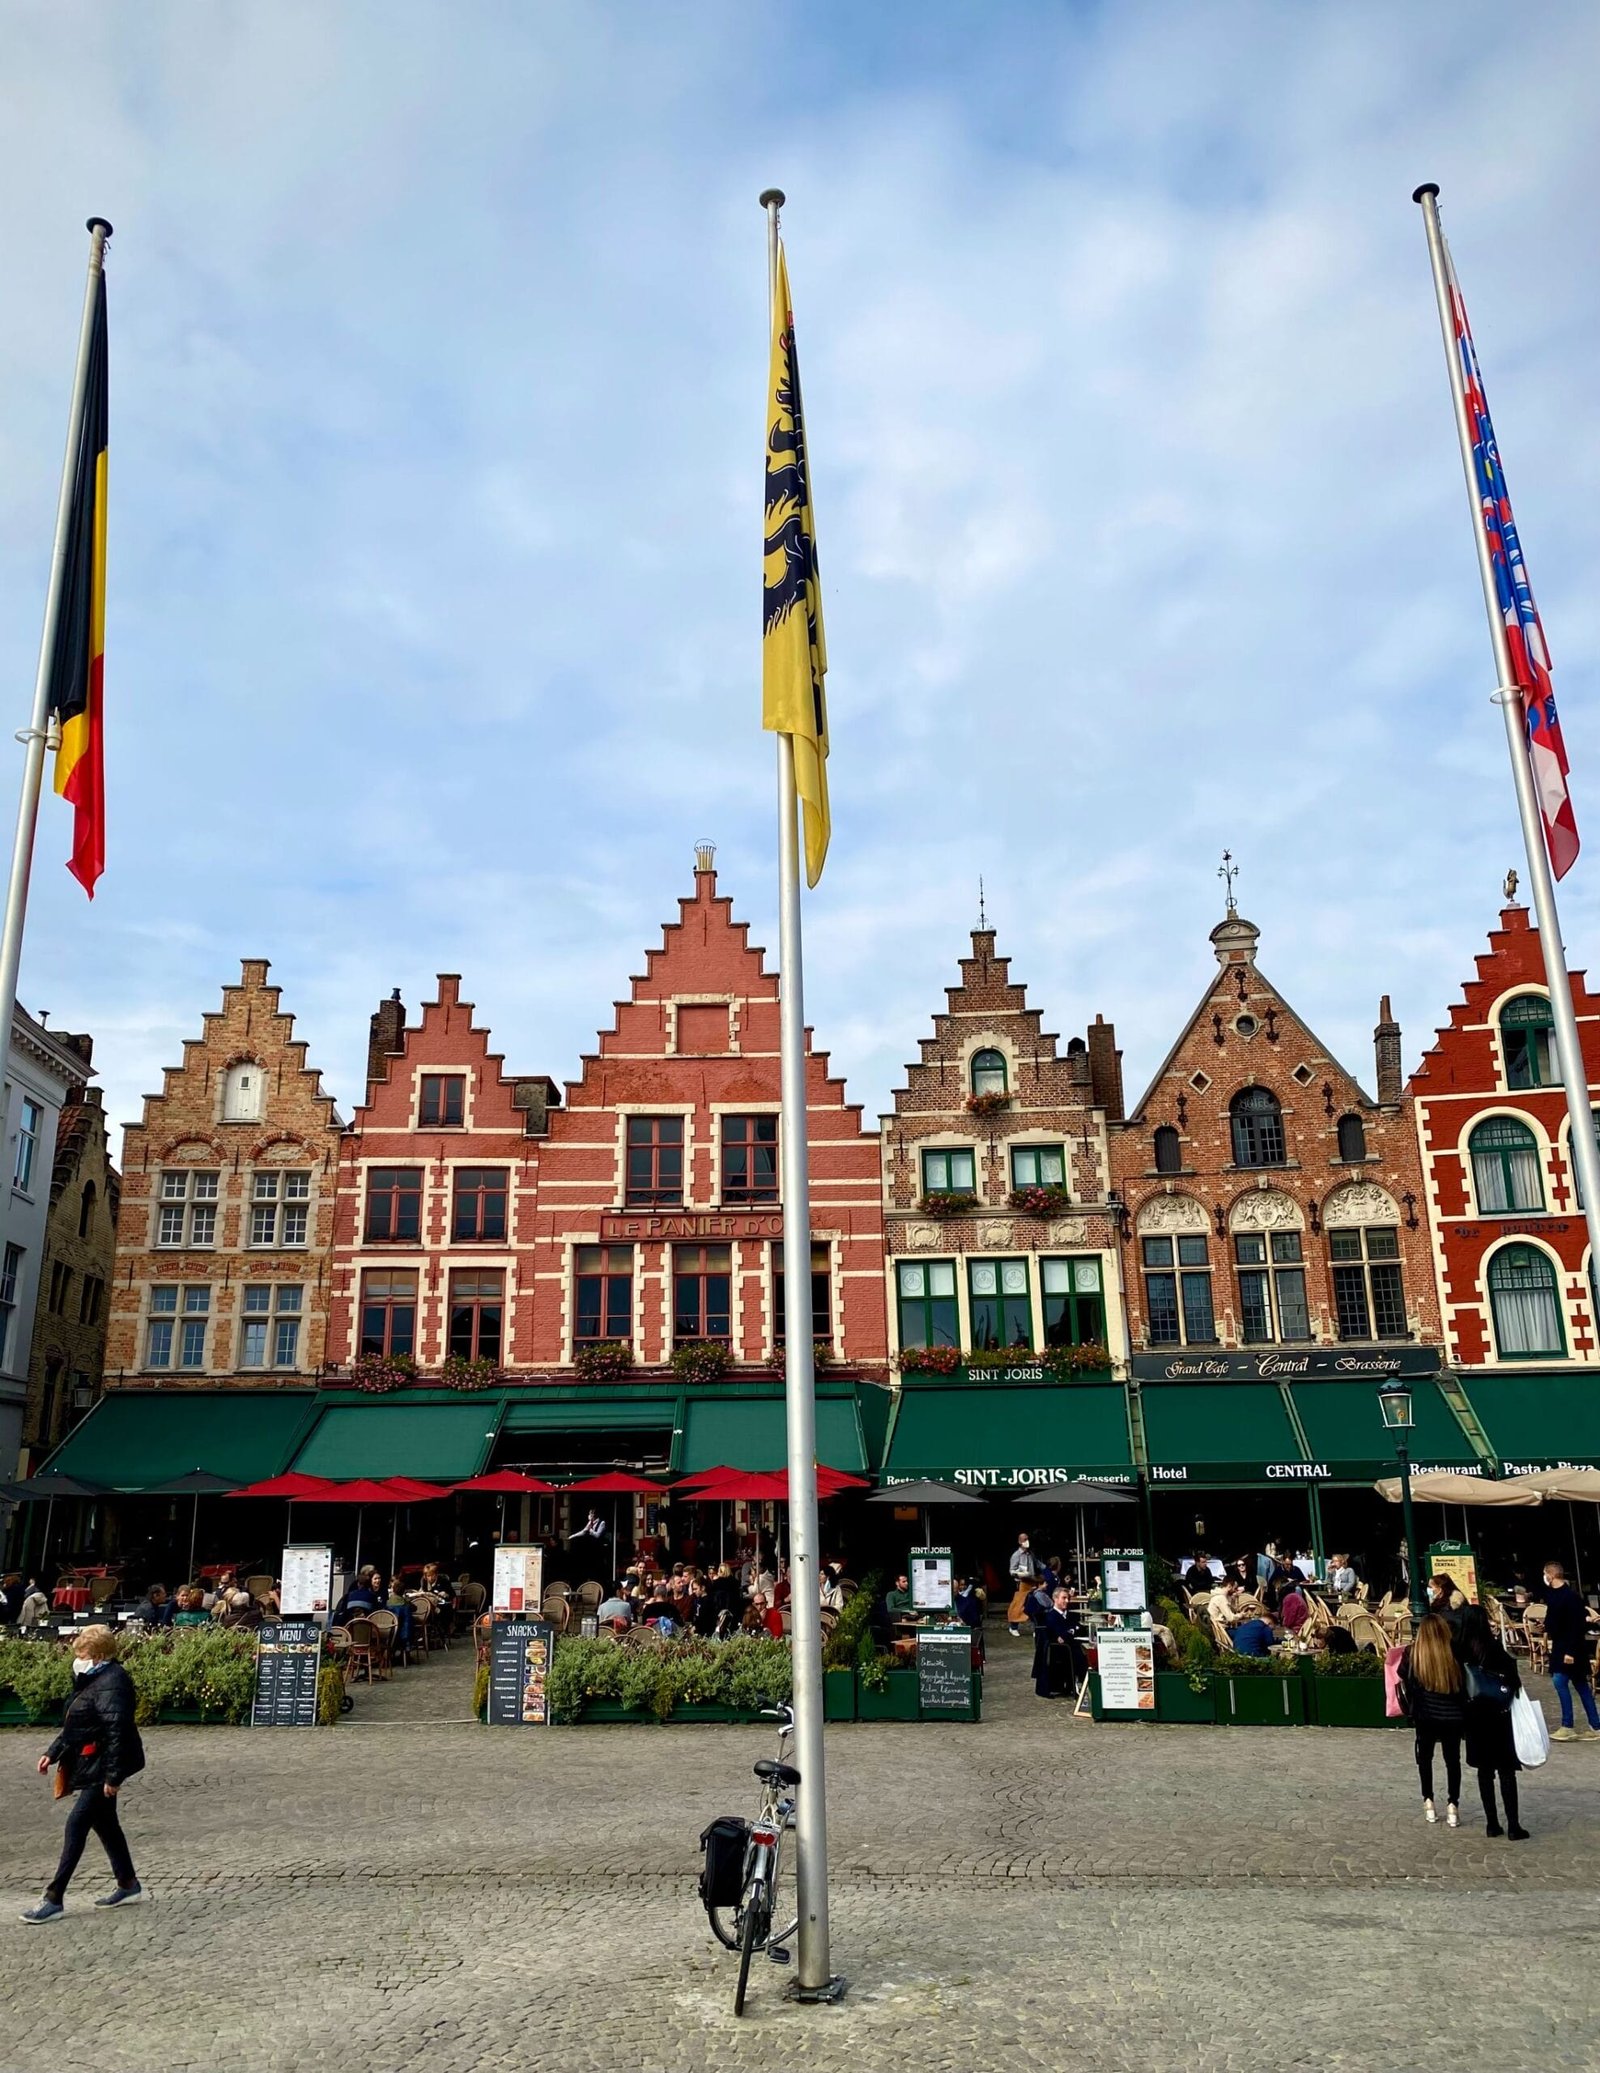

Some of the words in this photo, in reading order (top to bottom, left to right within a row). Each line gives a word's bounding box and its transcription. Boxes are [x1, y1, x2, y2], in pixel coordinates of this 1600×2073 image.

[608, 1222, 640, 1238] LE
[646, 1217, 737, 1237] PANIER
[744, 1217, 784, 1235] D'O
[1165, 1361, 1204, 1379] Grand
[1254, 1354, 1309, 1377] Central
[1335, 1357, 1402, 1371] Brasserie
[968, 1369, 1000, 1381] SINT
[1004, 1368, 1043, 1380] JORIS
[1152, 1466, 1188, 1479] Hotel
[1265, 1464, 1332, 1478] CENTRAL
[1503, 1462, 1541, 1475] Pasta
[953, 1468, 1068, 1486] SINT-JORIS
[910, 1546, 929, 1554] SINT
[930, 1546, 952, 1554] JORIS
[1103, 1548, 1121, 1556] SINT
[1122, 1548, 1145, 1556] JORIS
[279, 1629, 302, 1641] MENU
[506, 1625, 538, 1637] SNACKS
